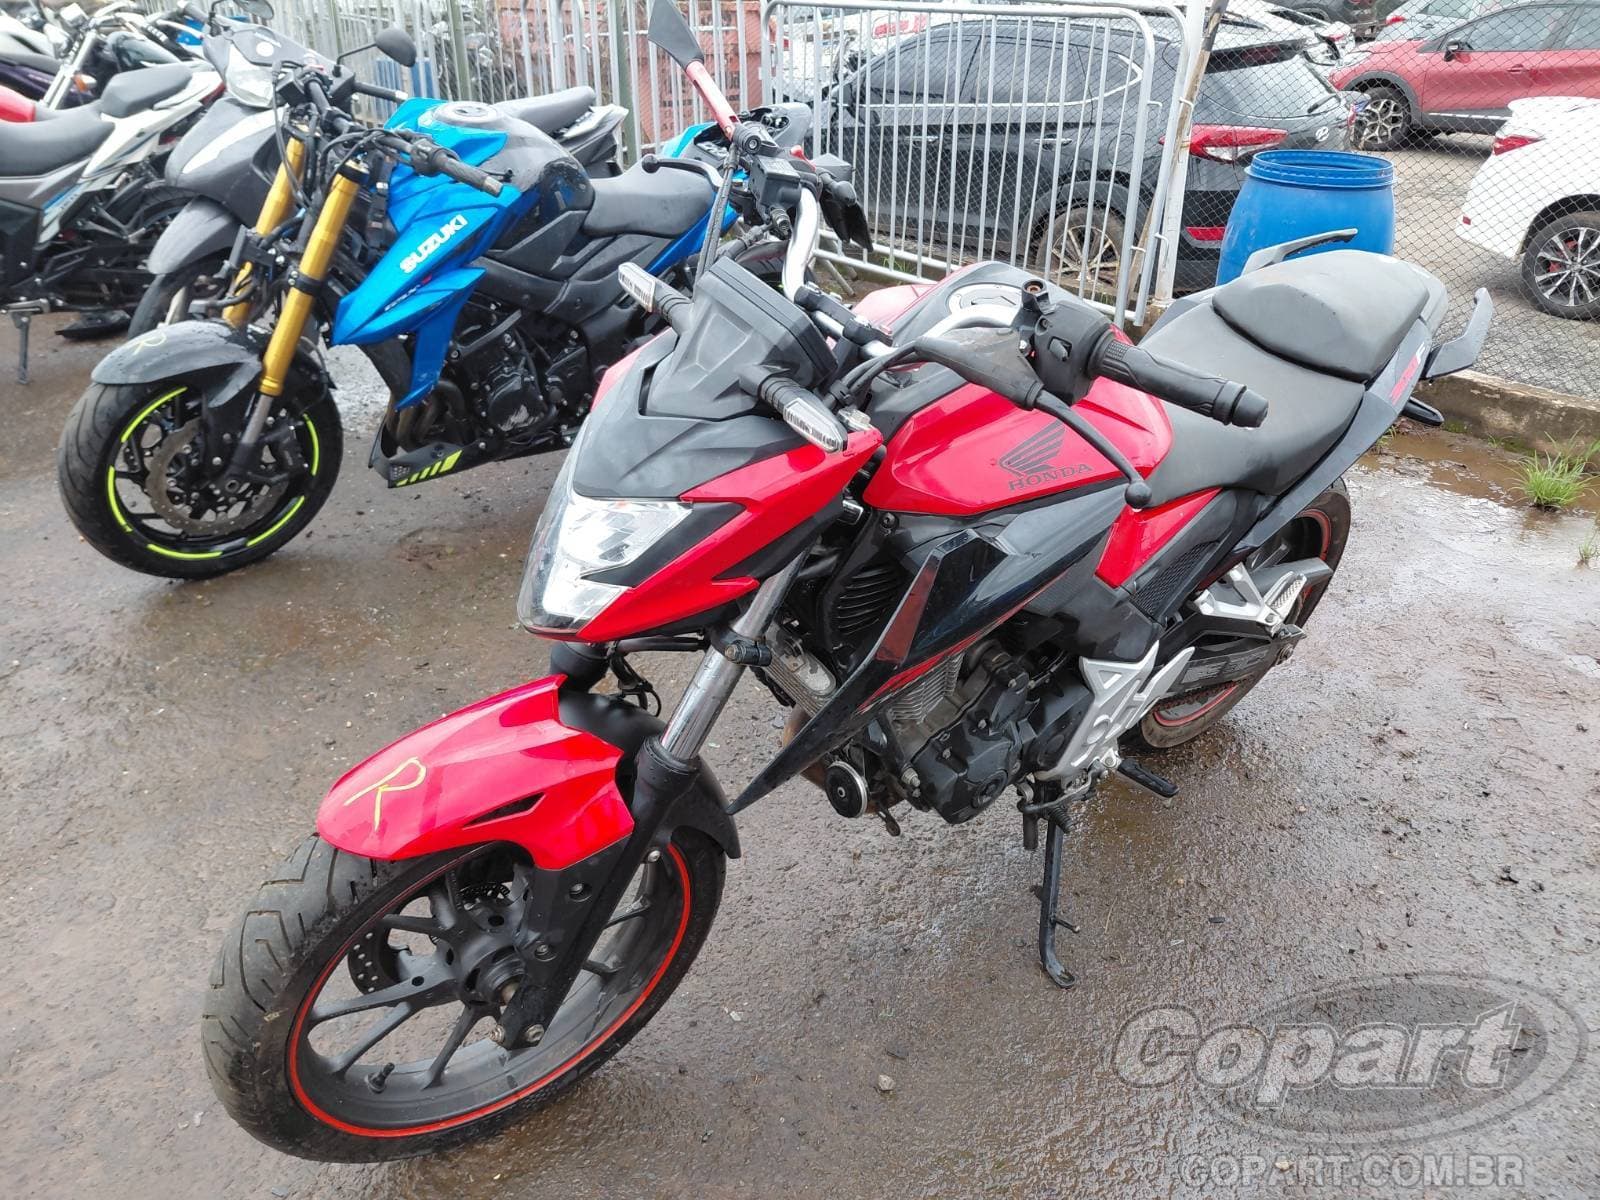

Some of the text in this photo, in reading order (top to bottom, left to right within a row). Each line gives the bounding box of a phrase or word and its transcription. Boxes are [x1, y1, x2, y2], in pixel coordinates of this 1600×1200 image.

[399, 214, 468, 274] SUZUKI
[1007, 463, 1093, 492] HONDA
[343, 756, 427, 831] R
